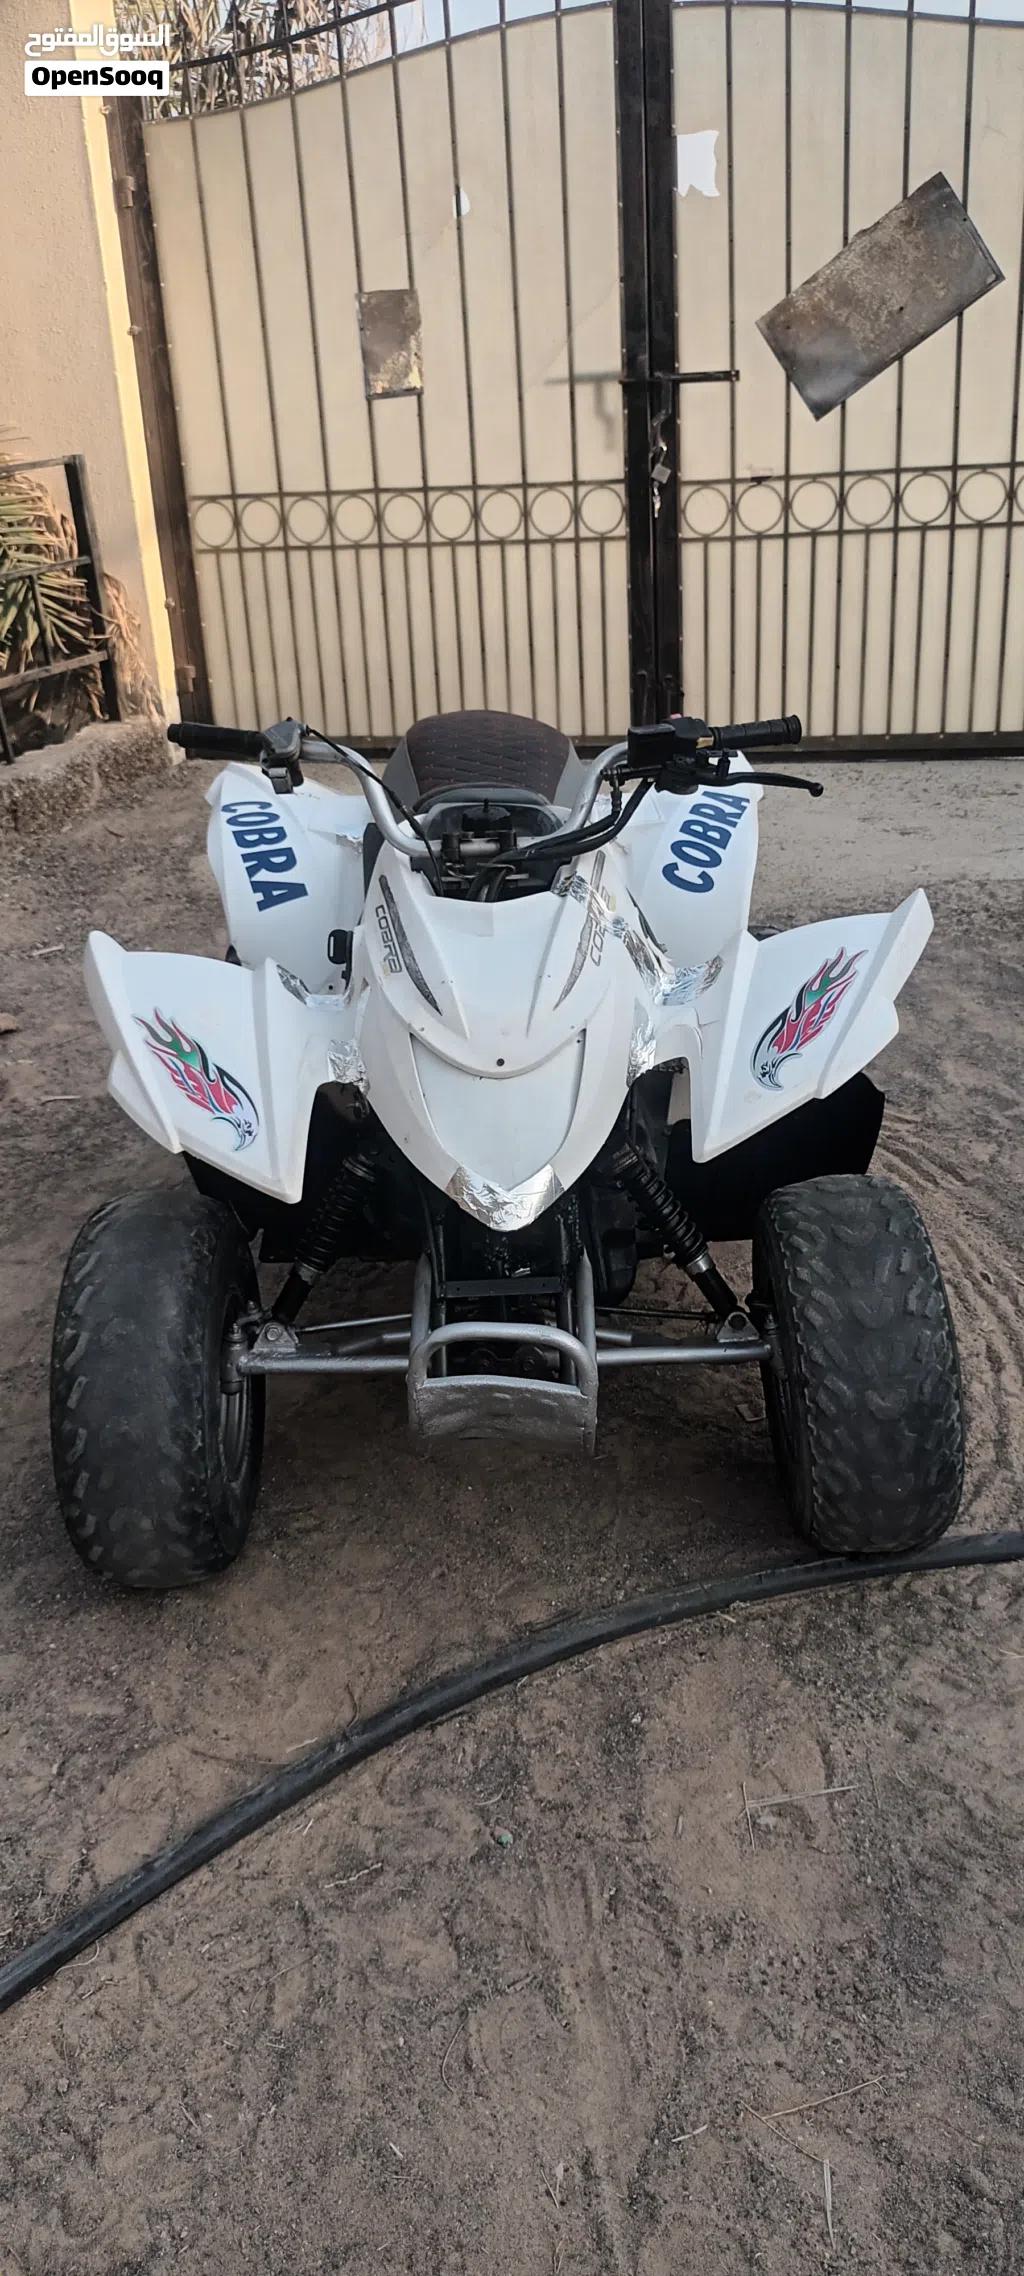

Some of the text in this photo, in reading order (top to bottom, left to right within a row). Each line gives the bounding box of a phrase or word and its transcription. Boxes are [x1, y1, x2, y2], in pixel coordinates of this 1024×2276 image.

[221, 801, 309, 912] COBRA
[661, 790, 750, 894] COBRA
[375, 904, 402, 973] COBRA
